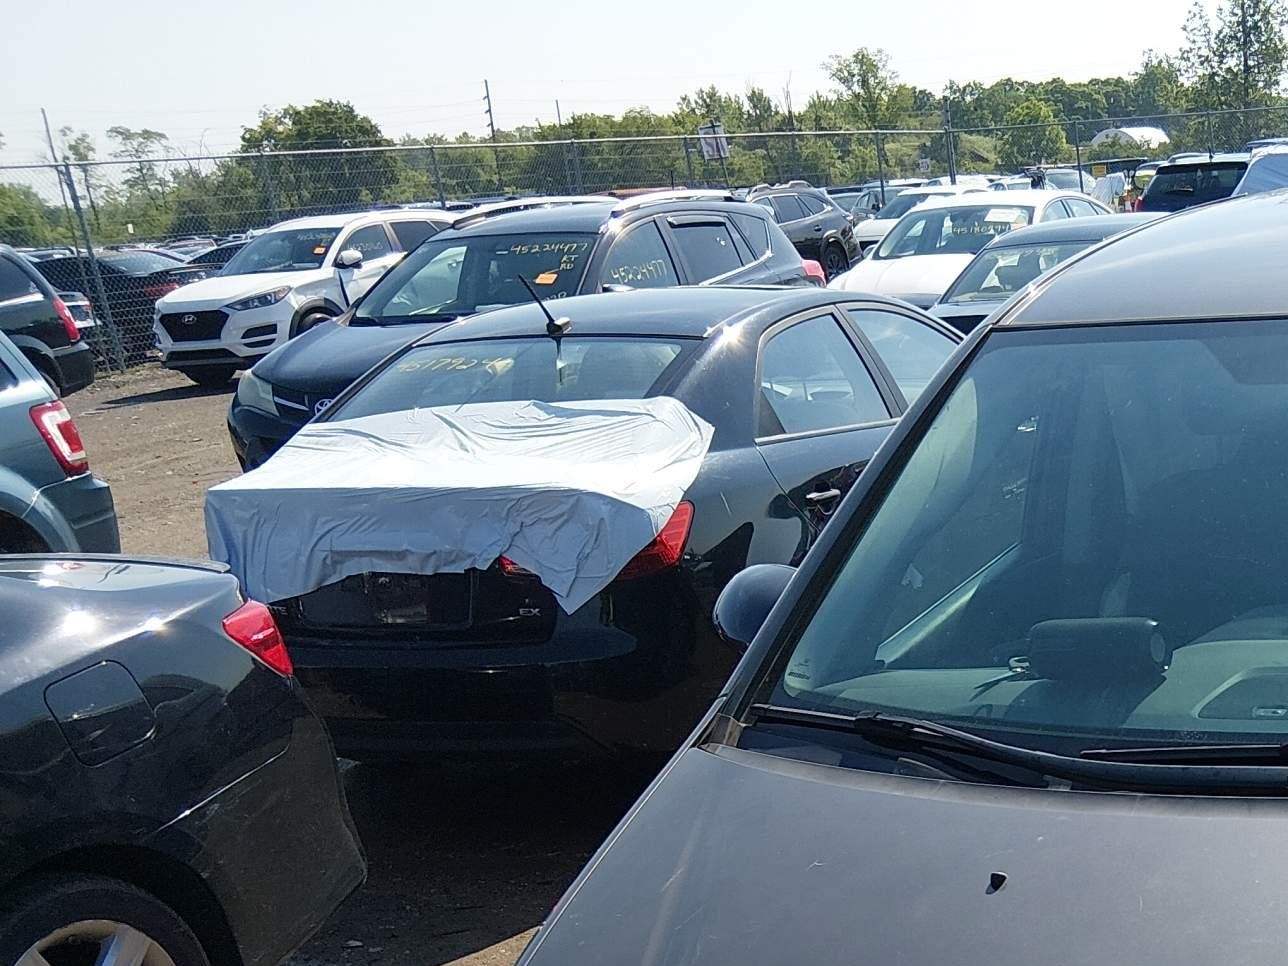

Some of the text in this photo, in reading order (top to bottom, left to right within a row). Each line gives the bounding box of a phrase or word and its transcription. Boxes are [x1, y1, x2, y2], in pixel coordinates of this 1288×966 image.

[511, 242, 588, 255] 45224477
[610, 259, 668, 285] 45224477
[519, 608, 541, 616] EX
